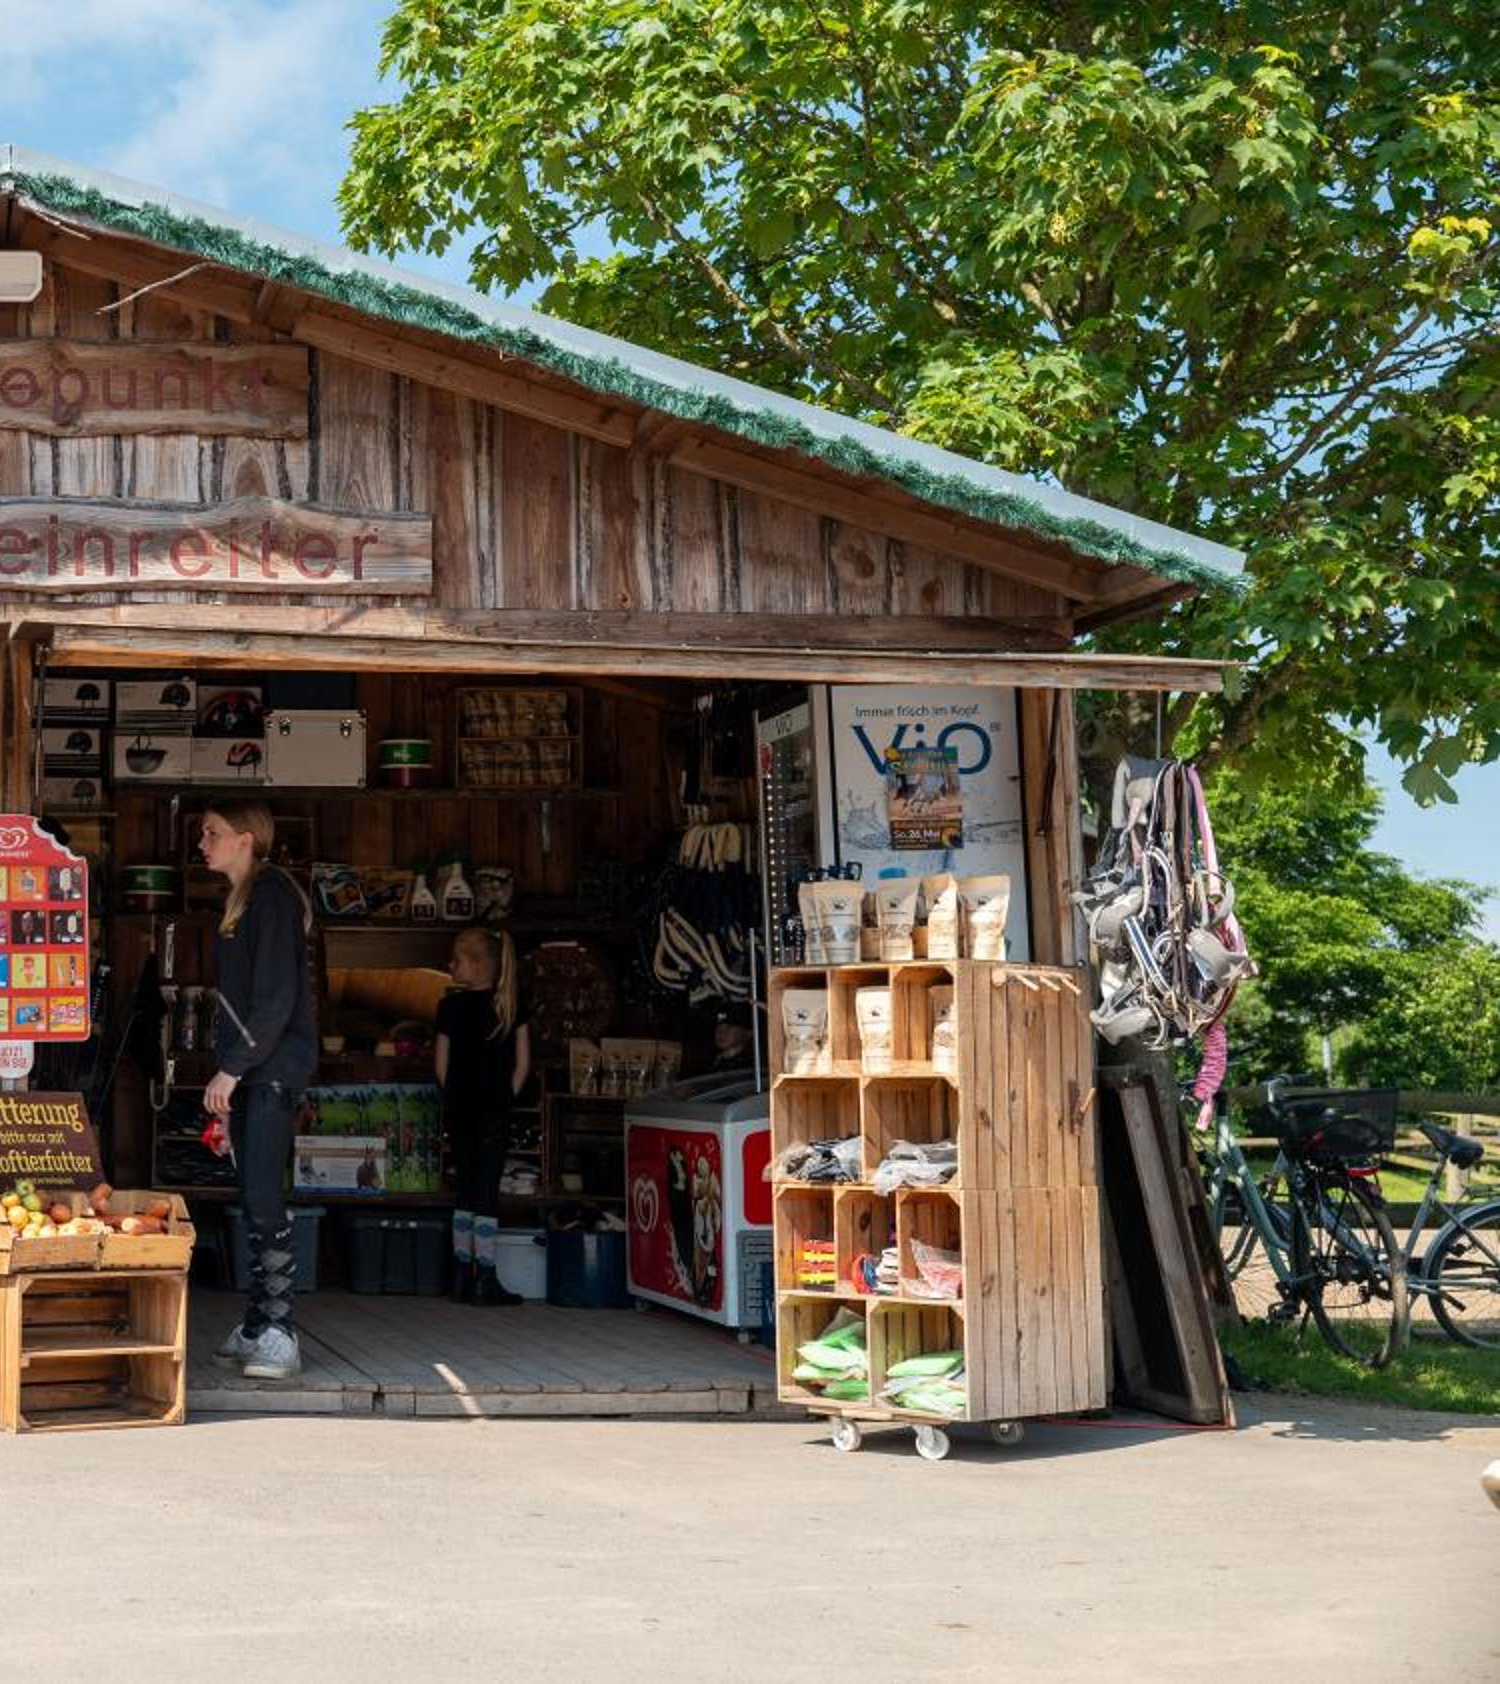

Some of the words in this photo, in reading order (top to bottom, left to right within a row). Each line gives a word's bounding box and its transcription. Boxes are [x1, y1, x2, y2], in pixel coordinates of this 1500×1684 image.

[855, 706, 894, 718] Immer
[897, 704, 930, 717] frisch
[27, 1133, 46, 1144] nur
[46, 1131, 67, 1145] mit
